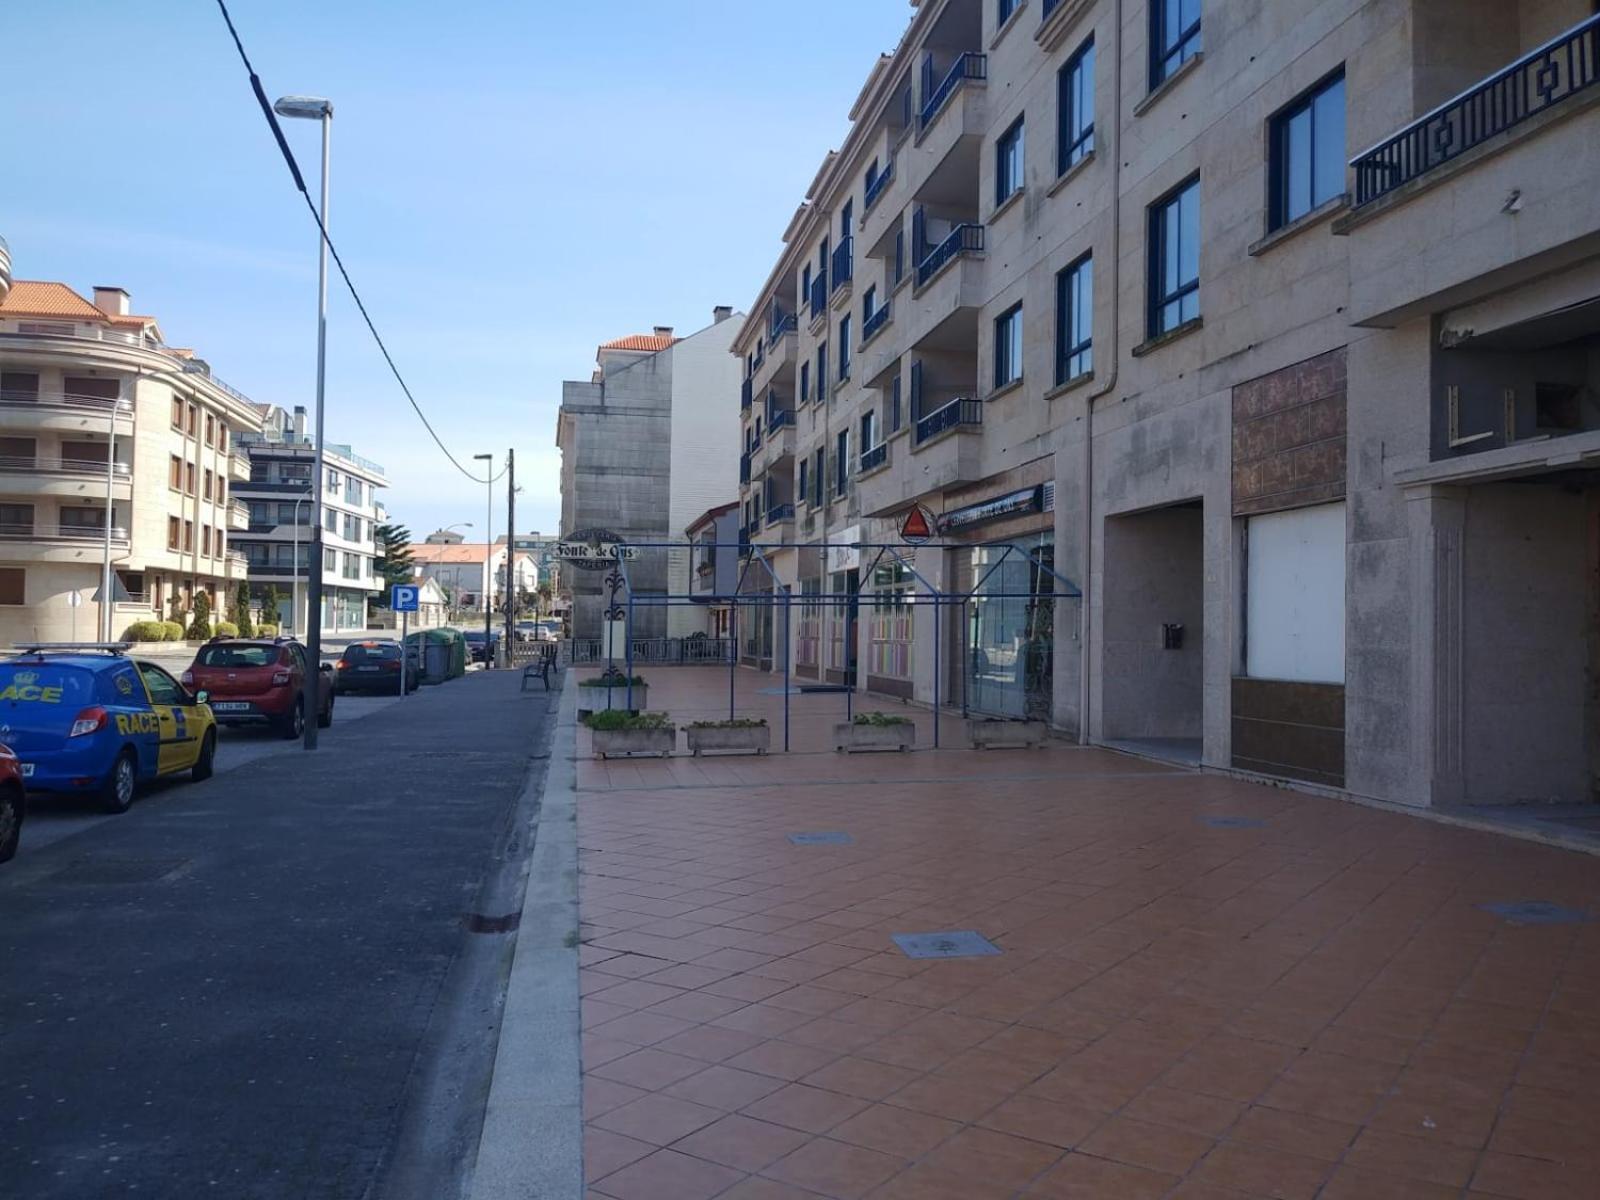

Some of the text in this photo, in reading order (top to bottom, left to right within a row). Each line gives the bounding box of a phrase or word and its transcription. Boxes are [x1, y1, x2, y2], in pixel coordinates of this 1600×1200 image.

[596, 547, 607, 557] de
[397, 588, 414, 609] P
[115, 712, 159, 735] RACE
